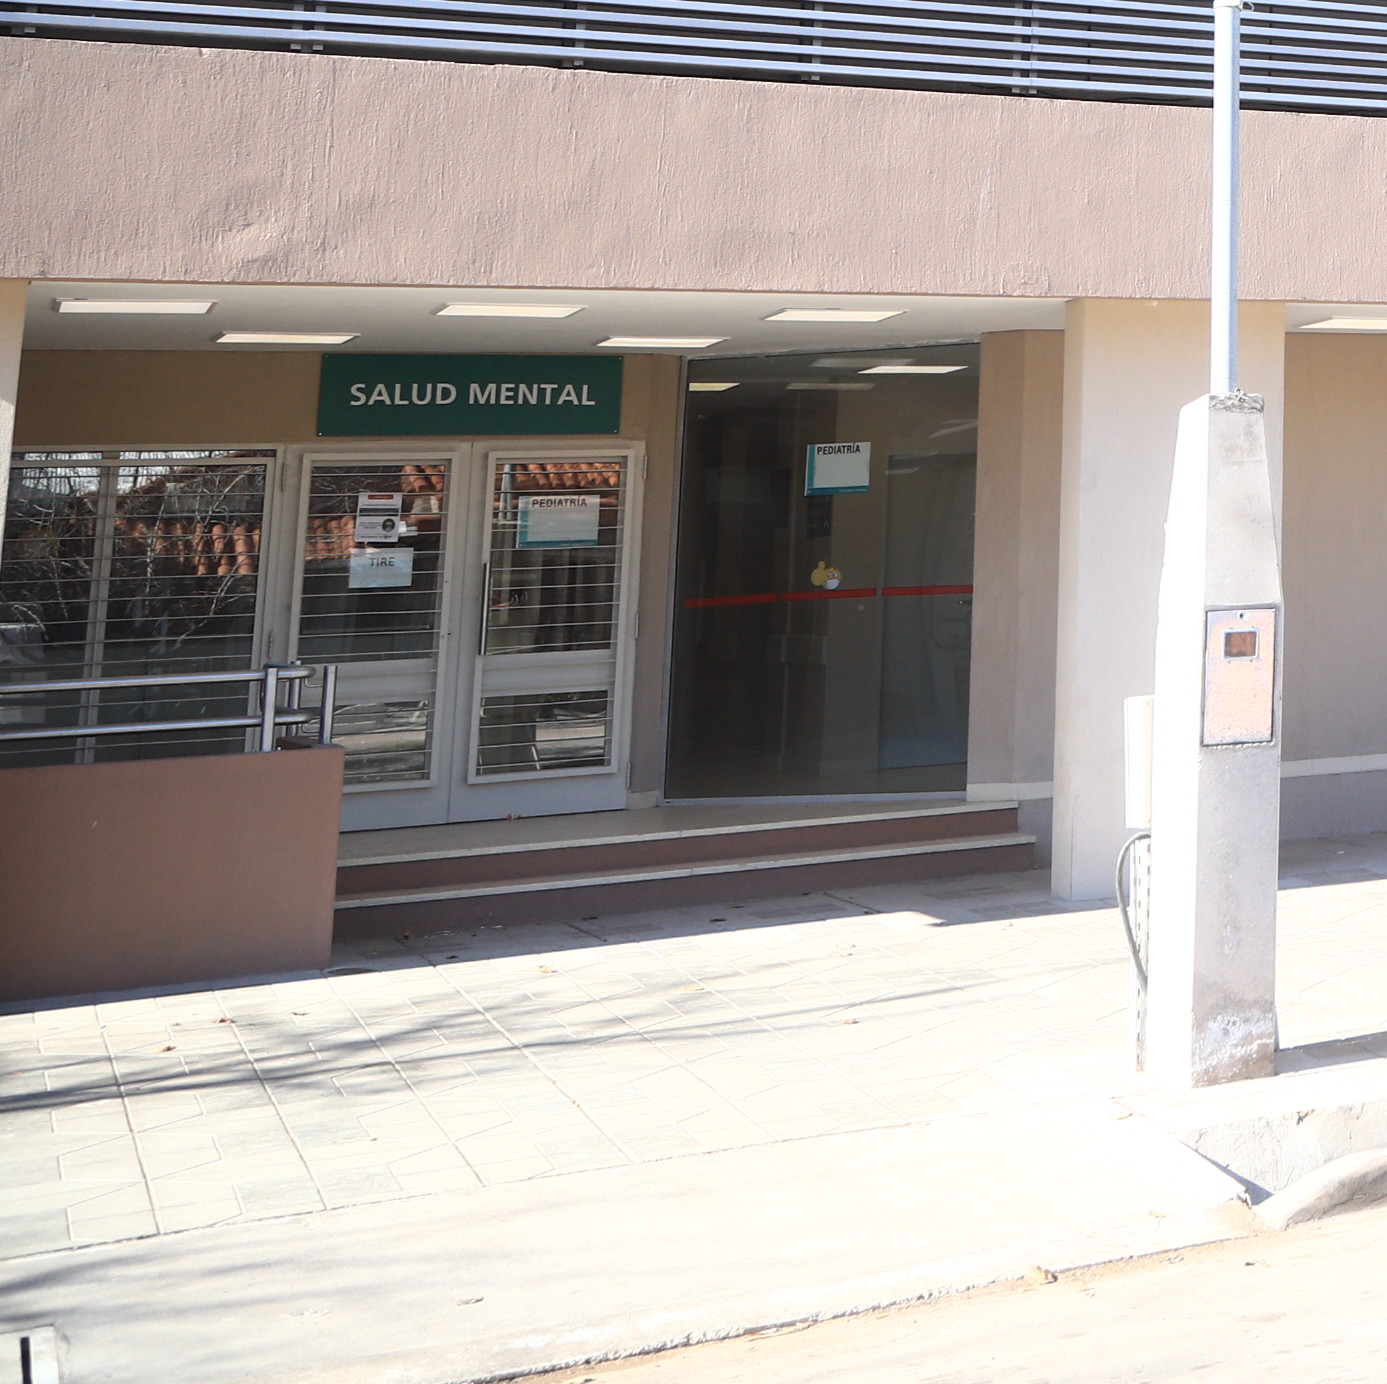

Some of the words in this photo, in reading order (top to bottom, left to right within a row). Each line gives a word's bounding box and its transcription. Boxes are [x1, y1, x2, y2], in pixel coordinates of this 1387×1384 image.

[350, 382, 457, 406] SALUD
[468, 383, 596, 406] MENTAL
[816, 442, 861, 456] PEDIATRÍA
[531, 496, 588, 508] PEDIATRÍA
[369, 557, 395, 567] TIRE
